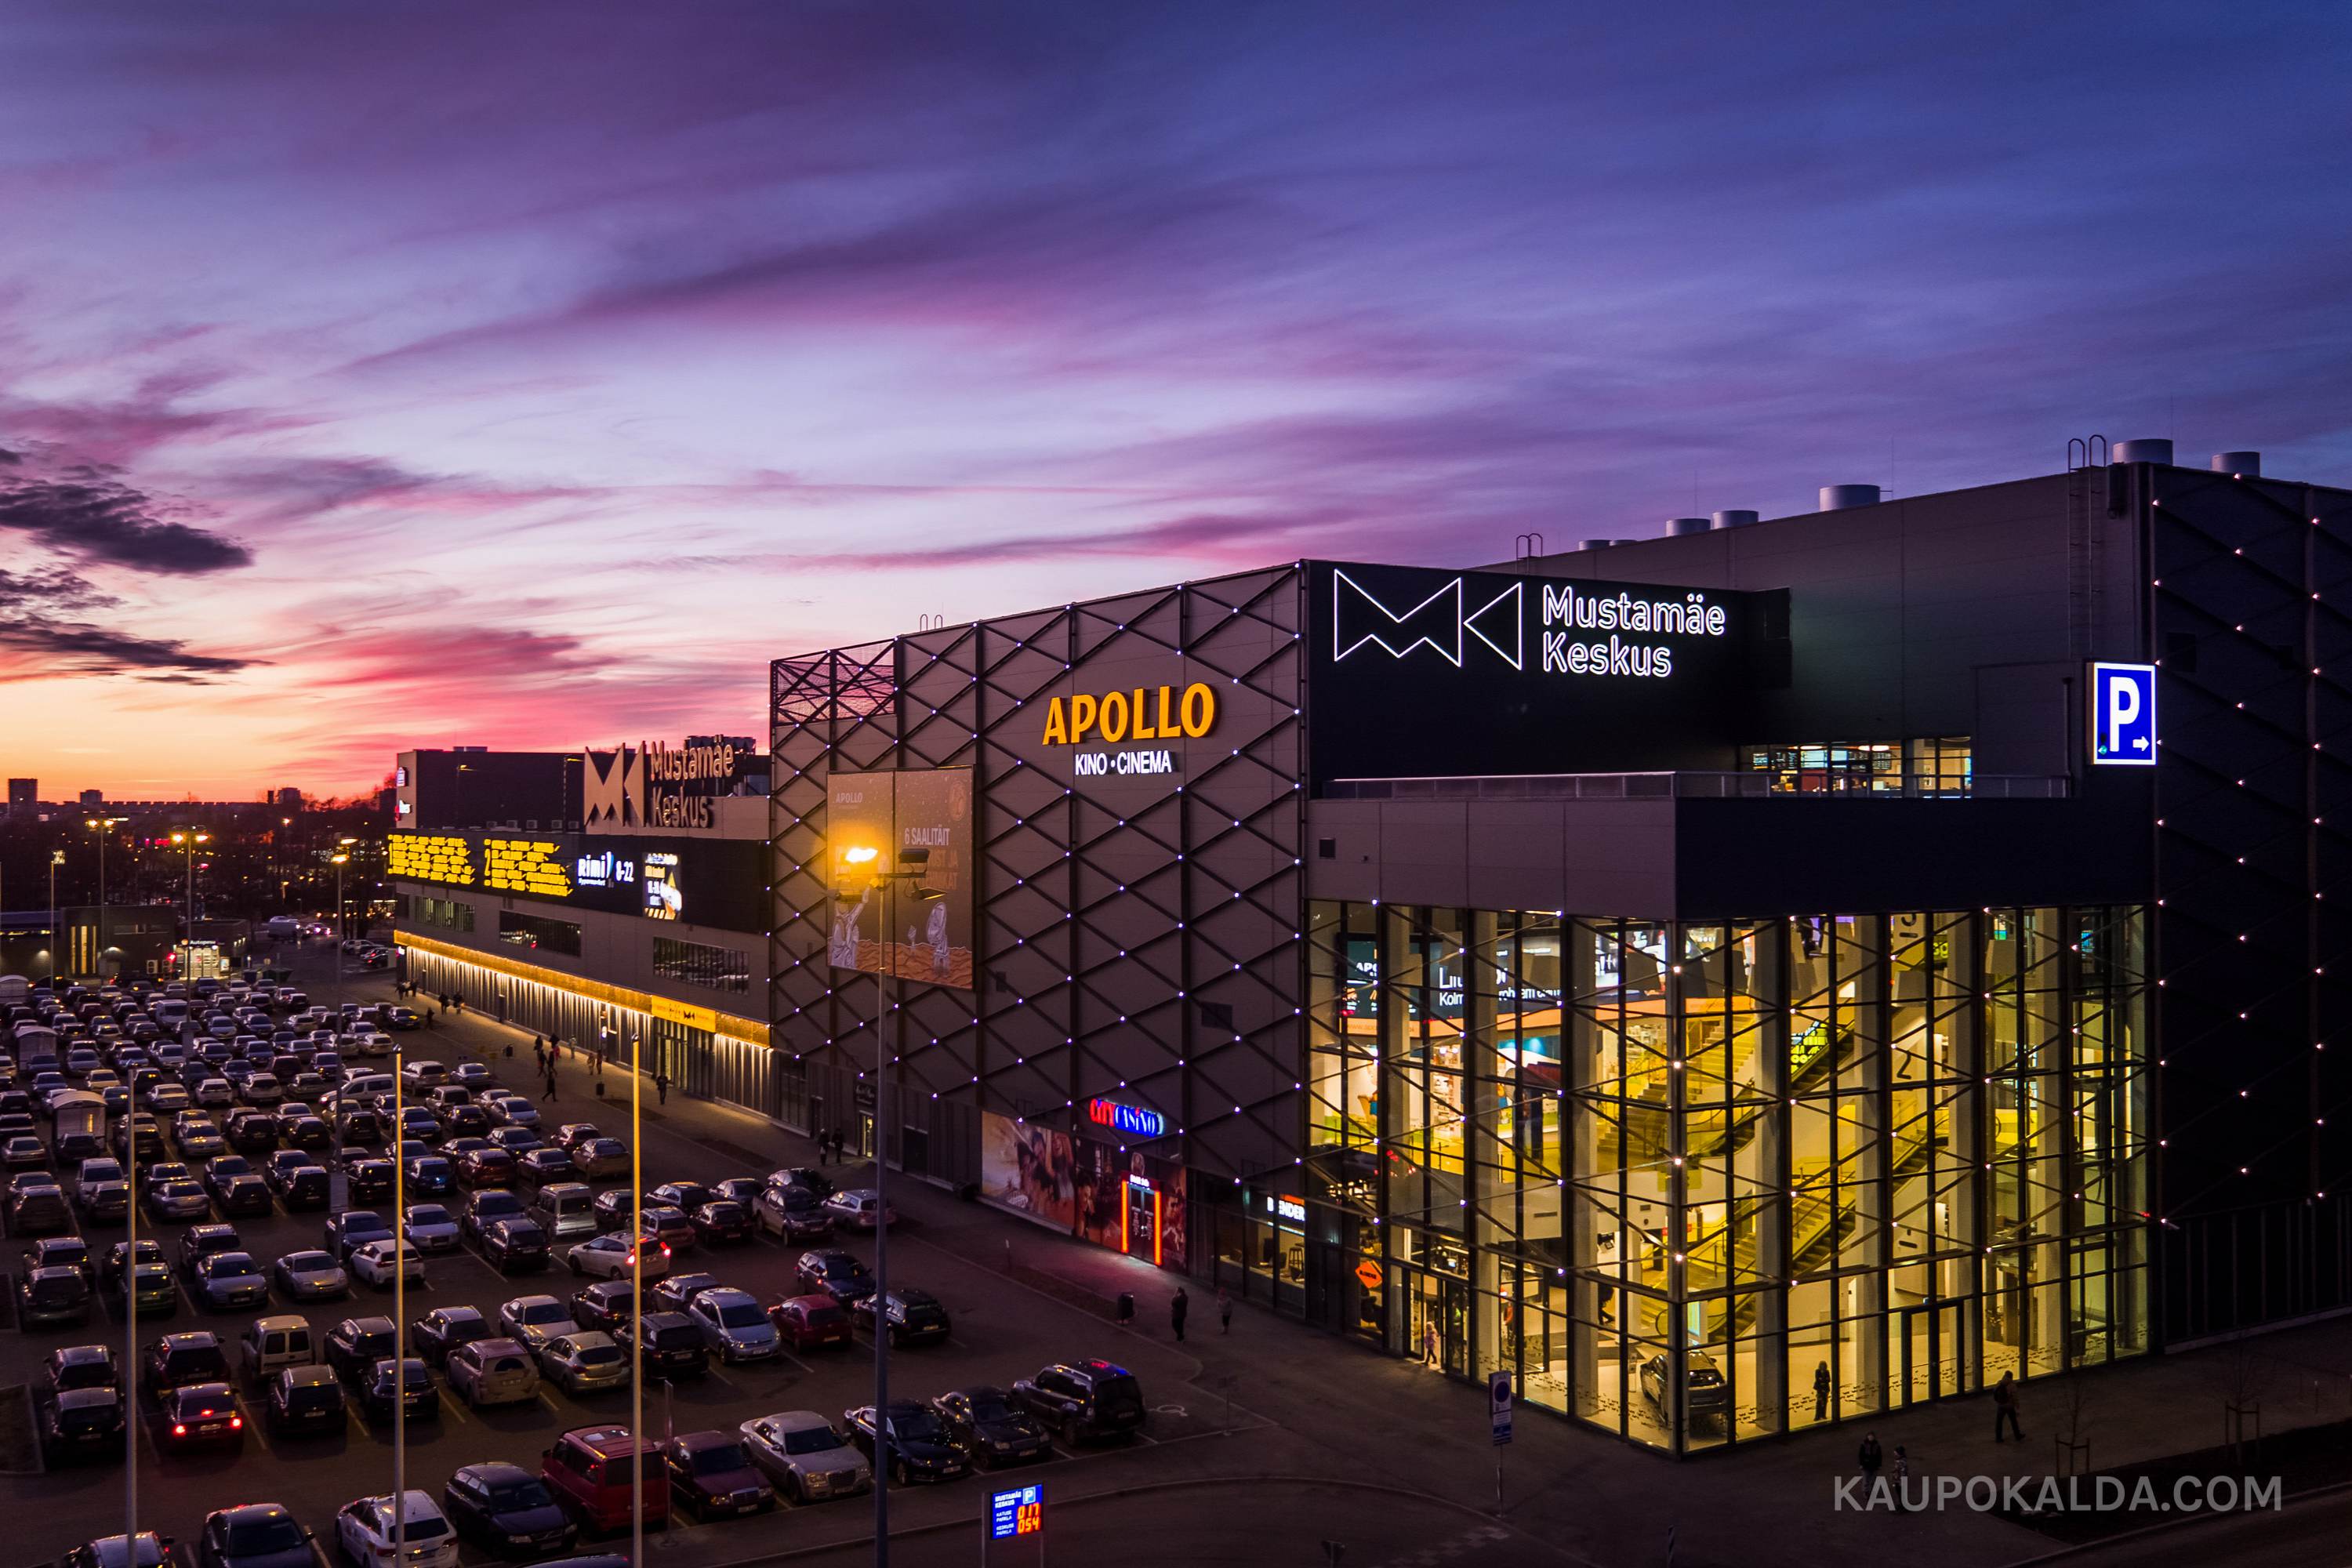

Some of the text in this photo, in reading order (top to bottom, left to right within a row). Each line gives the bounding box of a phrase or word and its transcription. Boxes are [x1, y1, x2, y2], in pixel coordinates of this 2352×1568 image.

[1543, 584, 1726, 636] Mustamäe
[1543, 631, 1672, 677] Keskus
[1042, 683, 1215, 746] APOLLO
[2110, 677, 2140, 752] P
[650, 734, 735, 782] Mustamäe
[1075, 750, 1172, 775] KINO CINEMA
[652, 786, 711, 829] Keskus
[836, 792, 863, 804] APOLLO
[904, 824, 950, 846] 6 SAALITÄIT
[578, 854, 606, 879] Rimi
[615, 860, 634, 883] 8-22
[1267, 1196, 1305, 1221] BENDER
[1018, 1503, 1040, 1520] 017
[1018, 1517, 1040, 1534] 054
